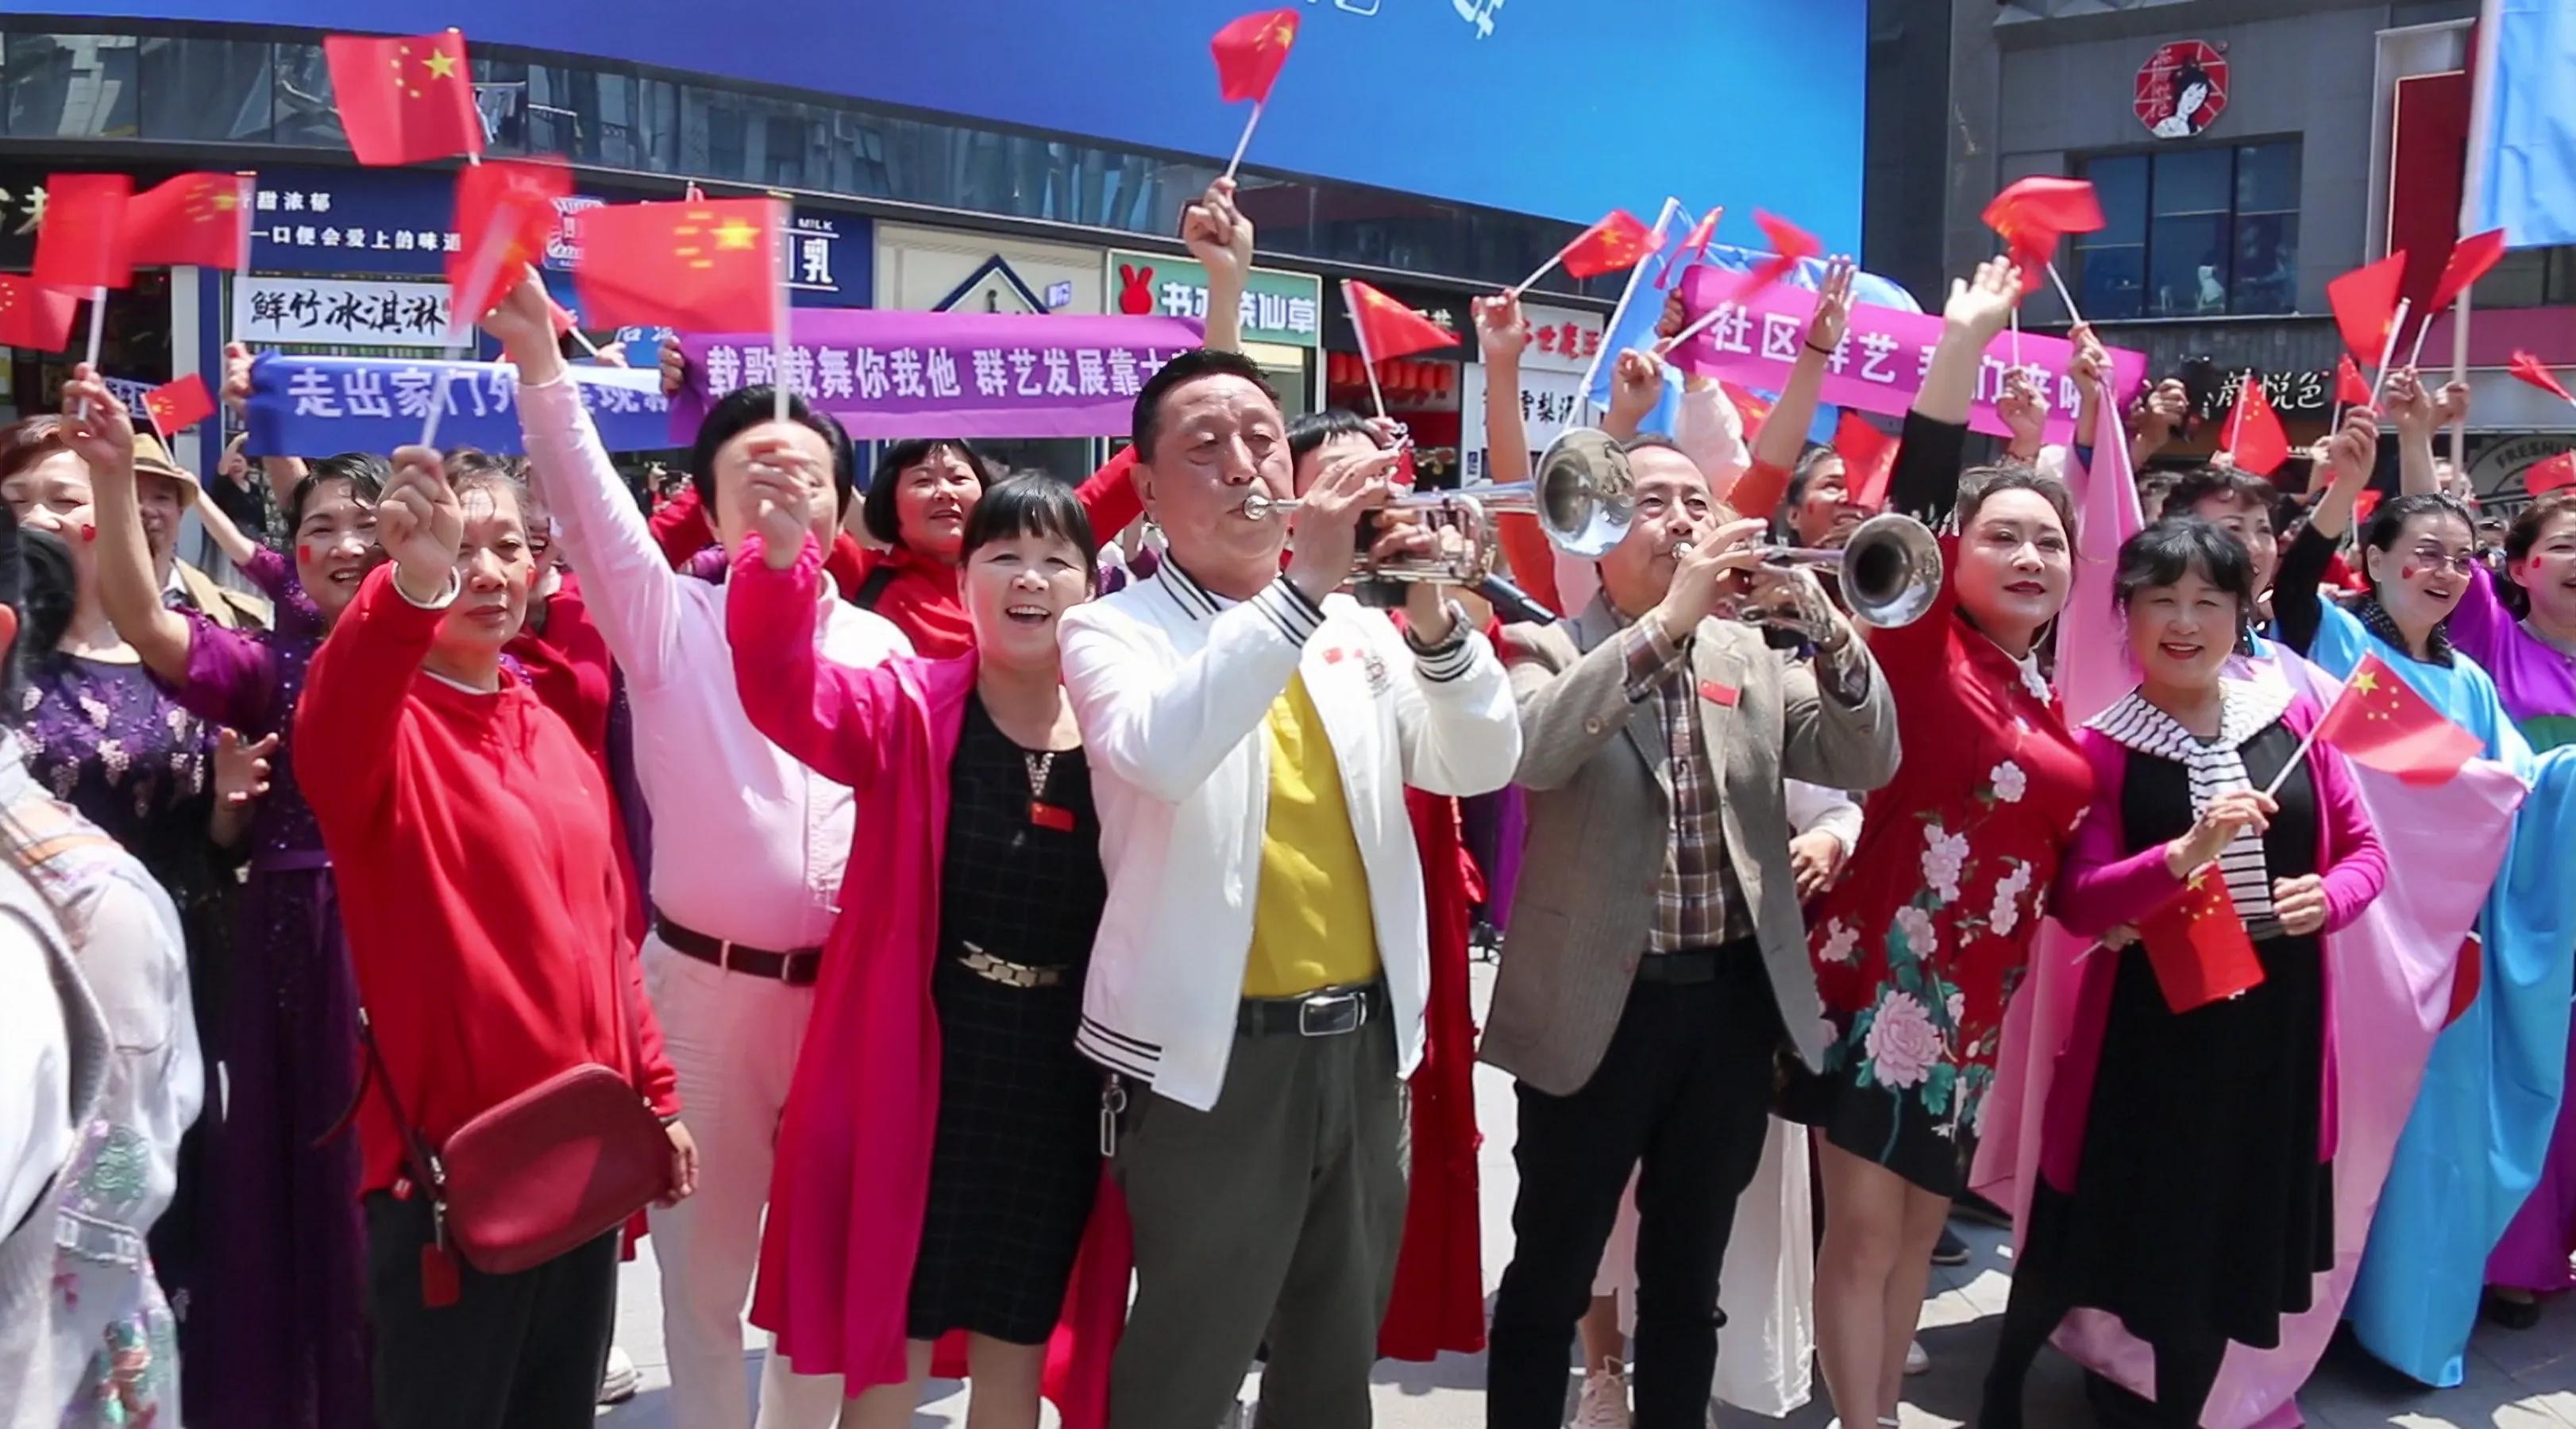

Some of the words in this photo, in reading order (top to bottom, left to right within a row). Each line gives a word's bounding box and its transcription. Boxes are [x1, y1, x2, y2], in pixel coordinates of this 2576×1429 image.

[249, 225, 461, 252] 一口便会爱上的味道
[797, 218, 833, 231] MILK
[250, 288, 446, 337] 鲜竹冰淇淋
[707, 345, 962, 399] 载歌载舞你我他
[972, 347, 1183, 397] 群艺发展靠大
[2207, 370, 2325, 410] 颜悦色
